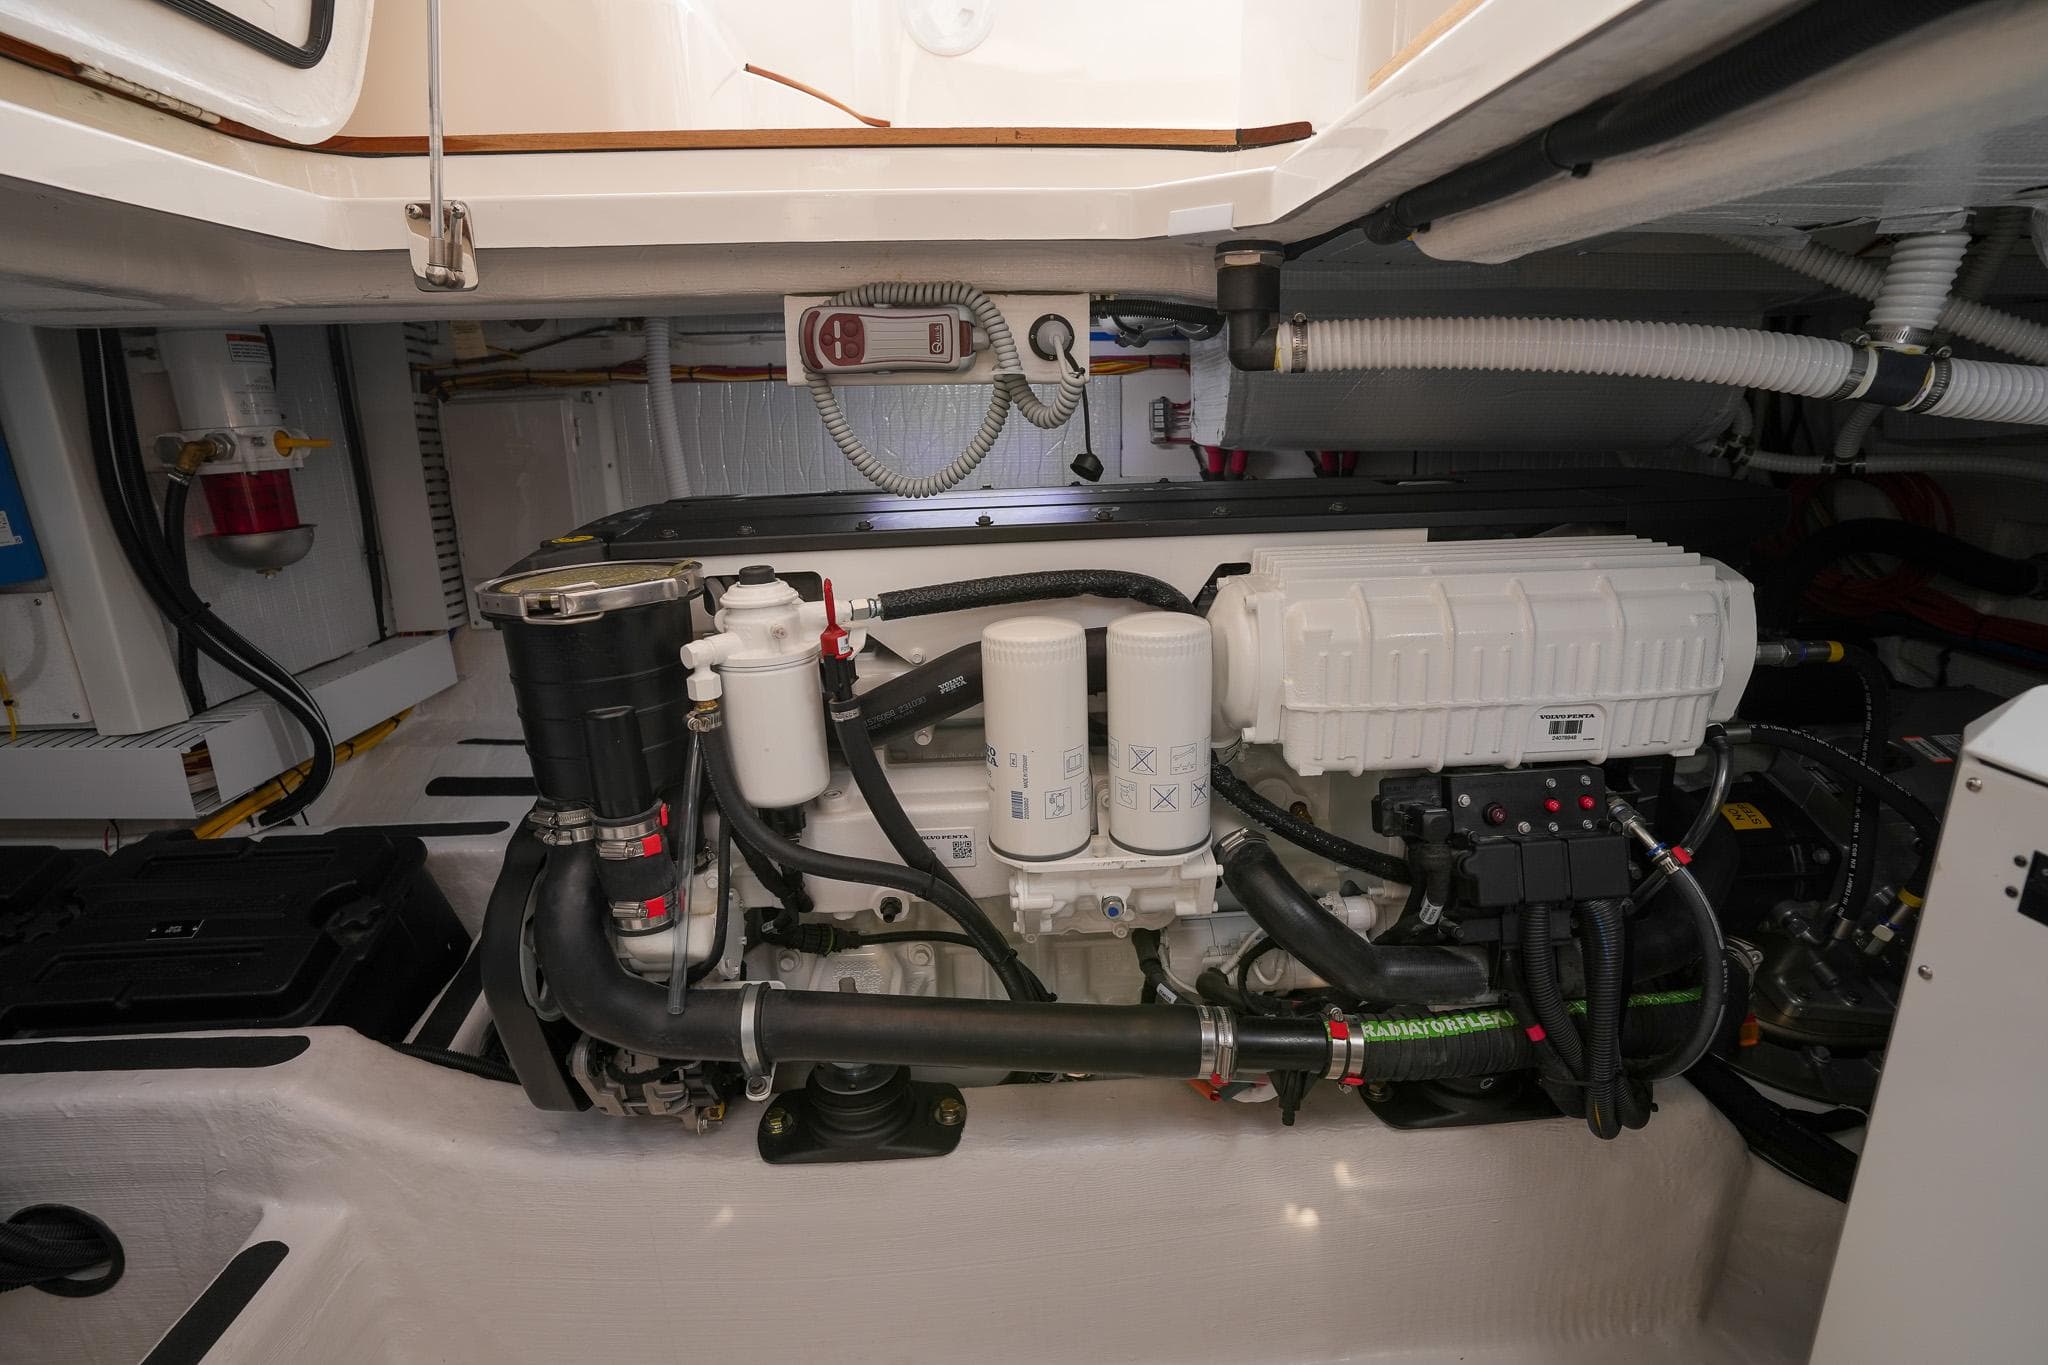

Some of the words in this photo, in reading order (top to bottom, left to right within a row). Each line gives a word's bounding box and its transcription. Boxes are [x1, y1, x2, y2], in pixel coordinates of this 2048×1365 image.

[931, 324, 943, 353] Quick
[938, 675, 965, 690] VOLVO
[939, 680, 967, 694] PENTA
[1361, 1012, 1507, 1039] RADIATORFLEX
